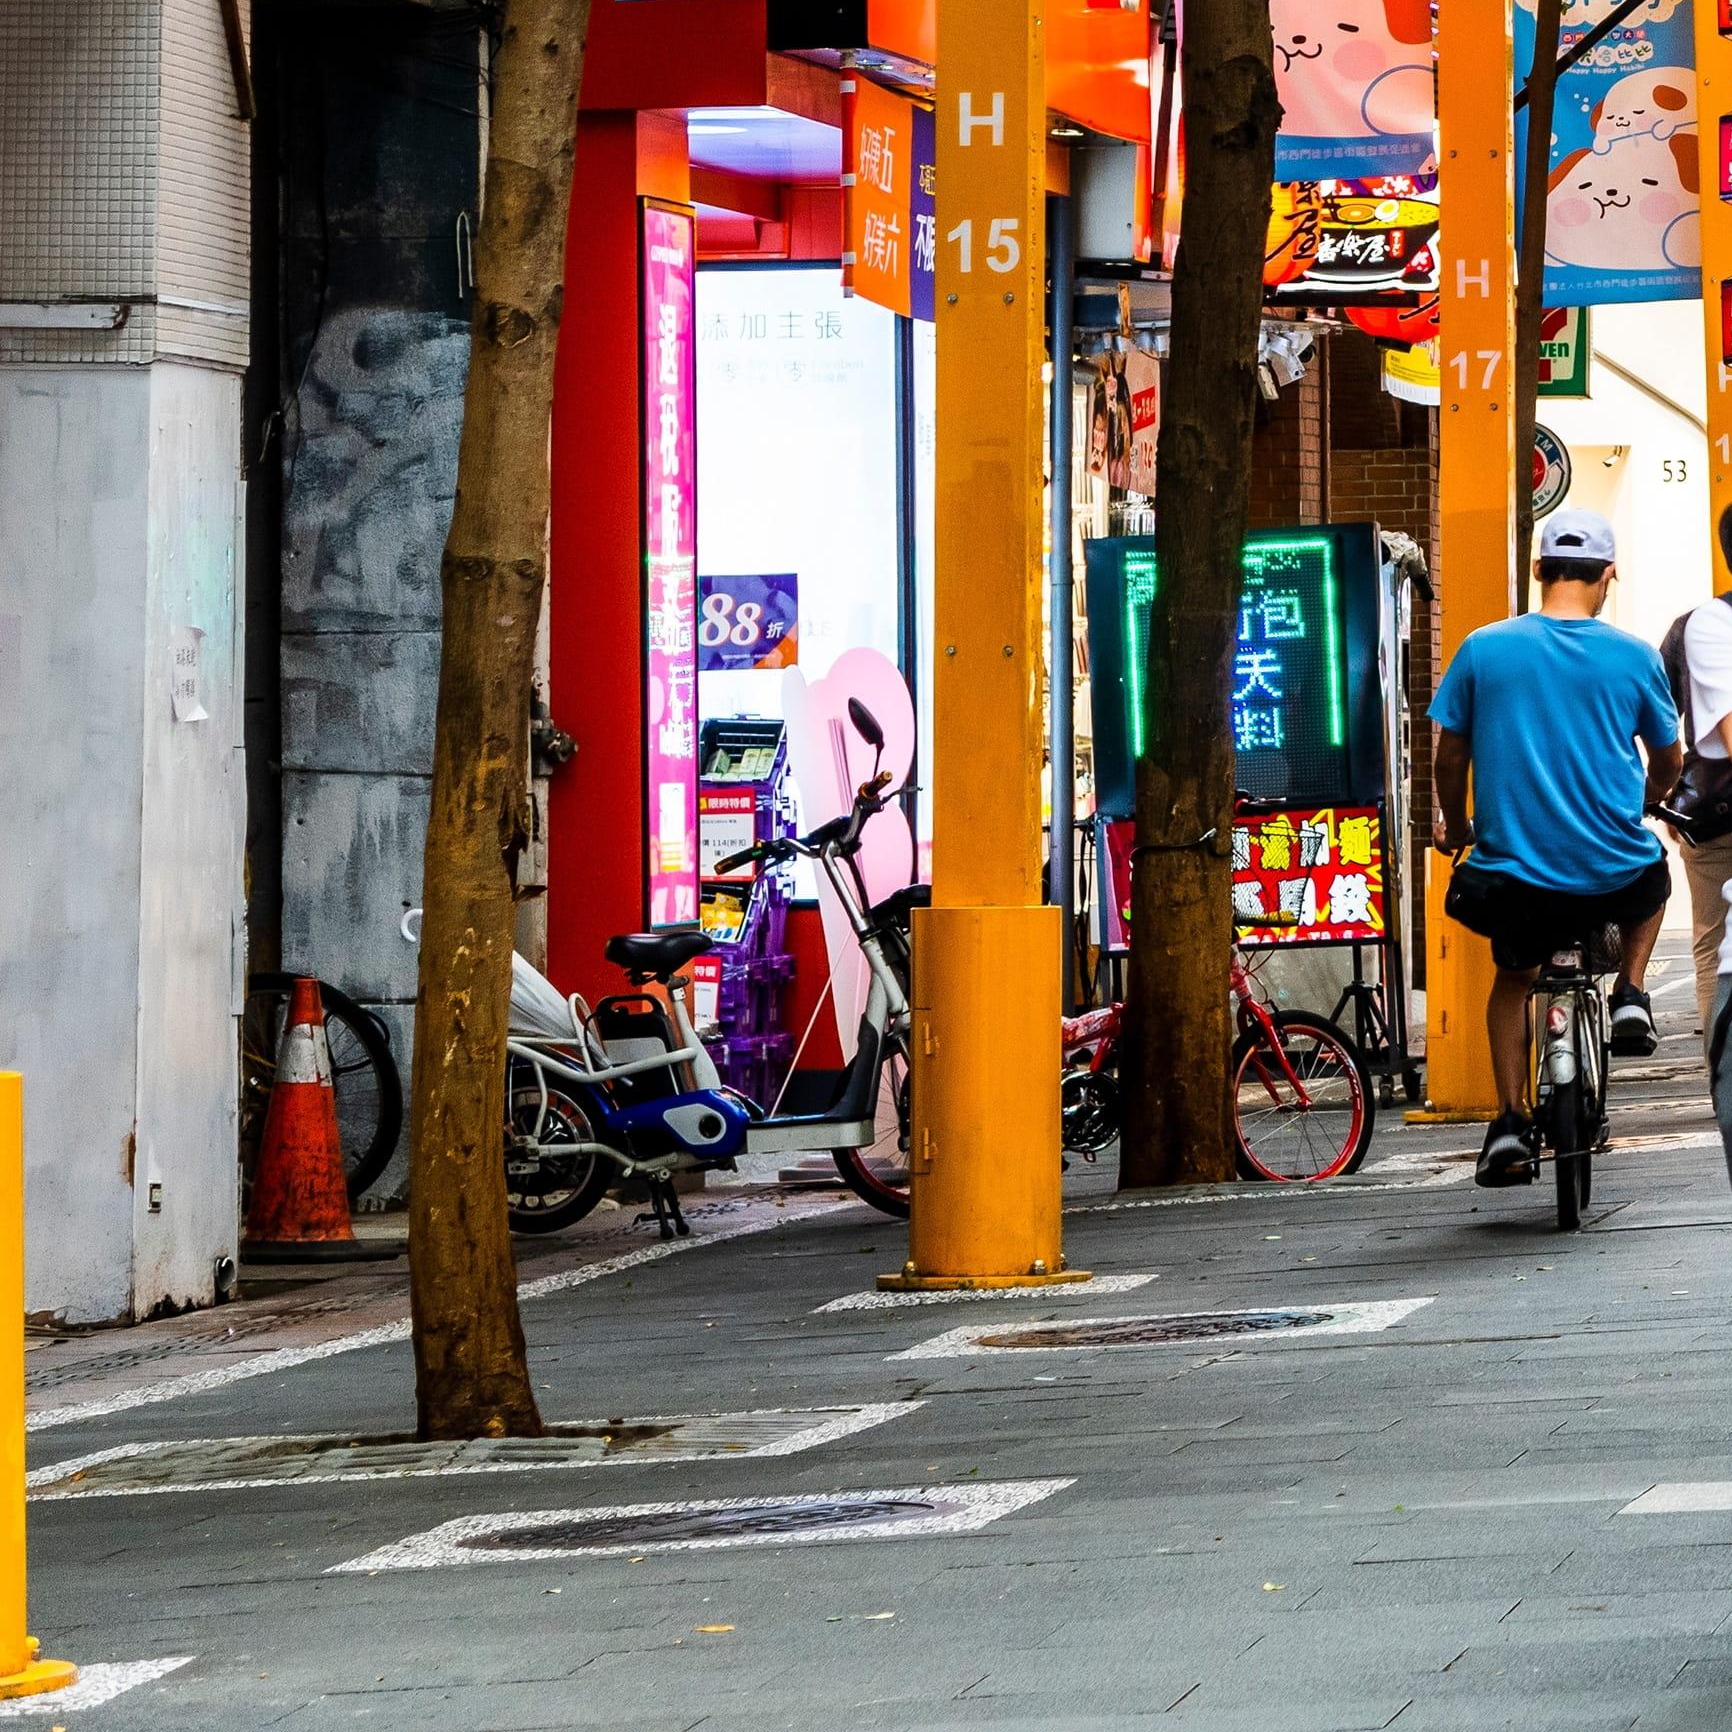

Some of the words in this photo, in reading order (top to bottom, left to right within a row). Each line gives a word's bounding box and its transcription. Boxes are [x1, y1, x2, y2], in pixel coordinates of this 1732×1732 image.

[958, 92, 1005, 147] H
[948, 218, 1021, 274] 15
[1456, 259, 1491, 299] H
[1450, 351, 1502, 390] 17
[1535, 432, 1554, 453] TM
[1663, 459, 1688, 483] 53
